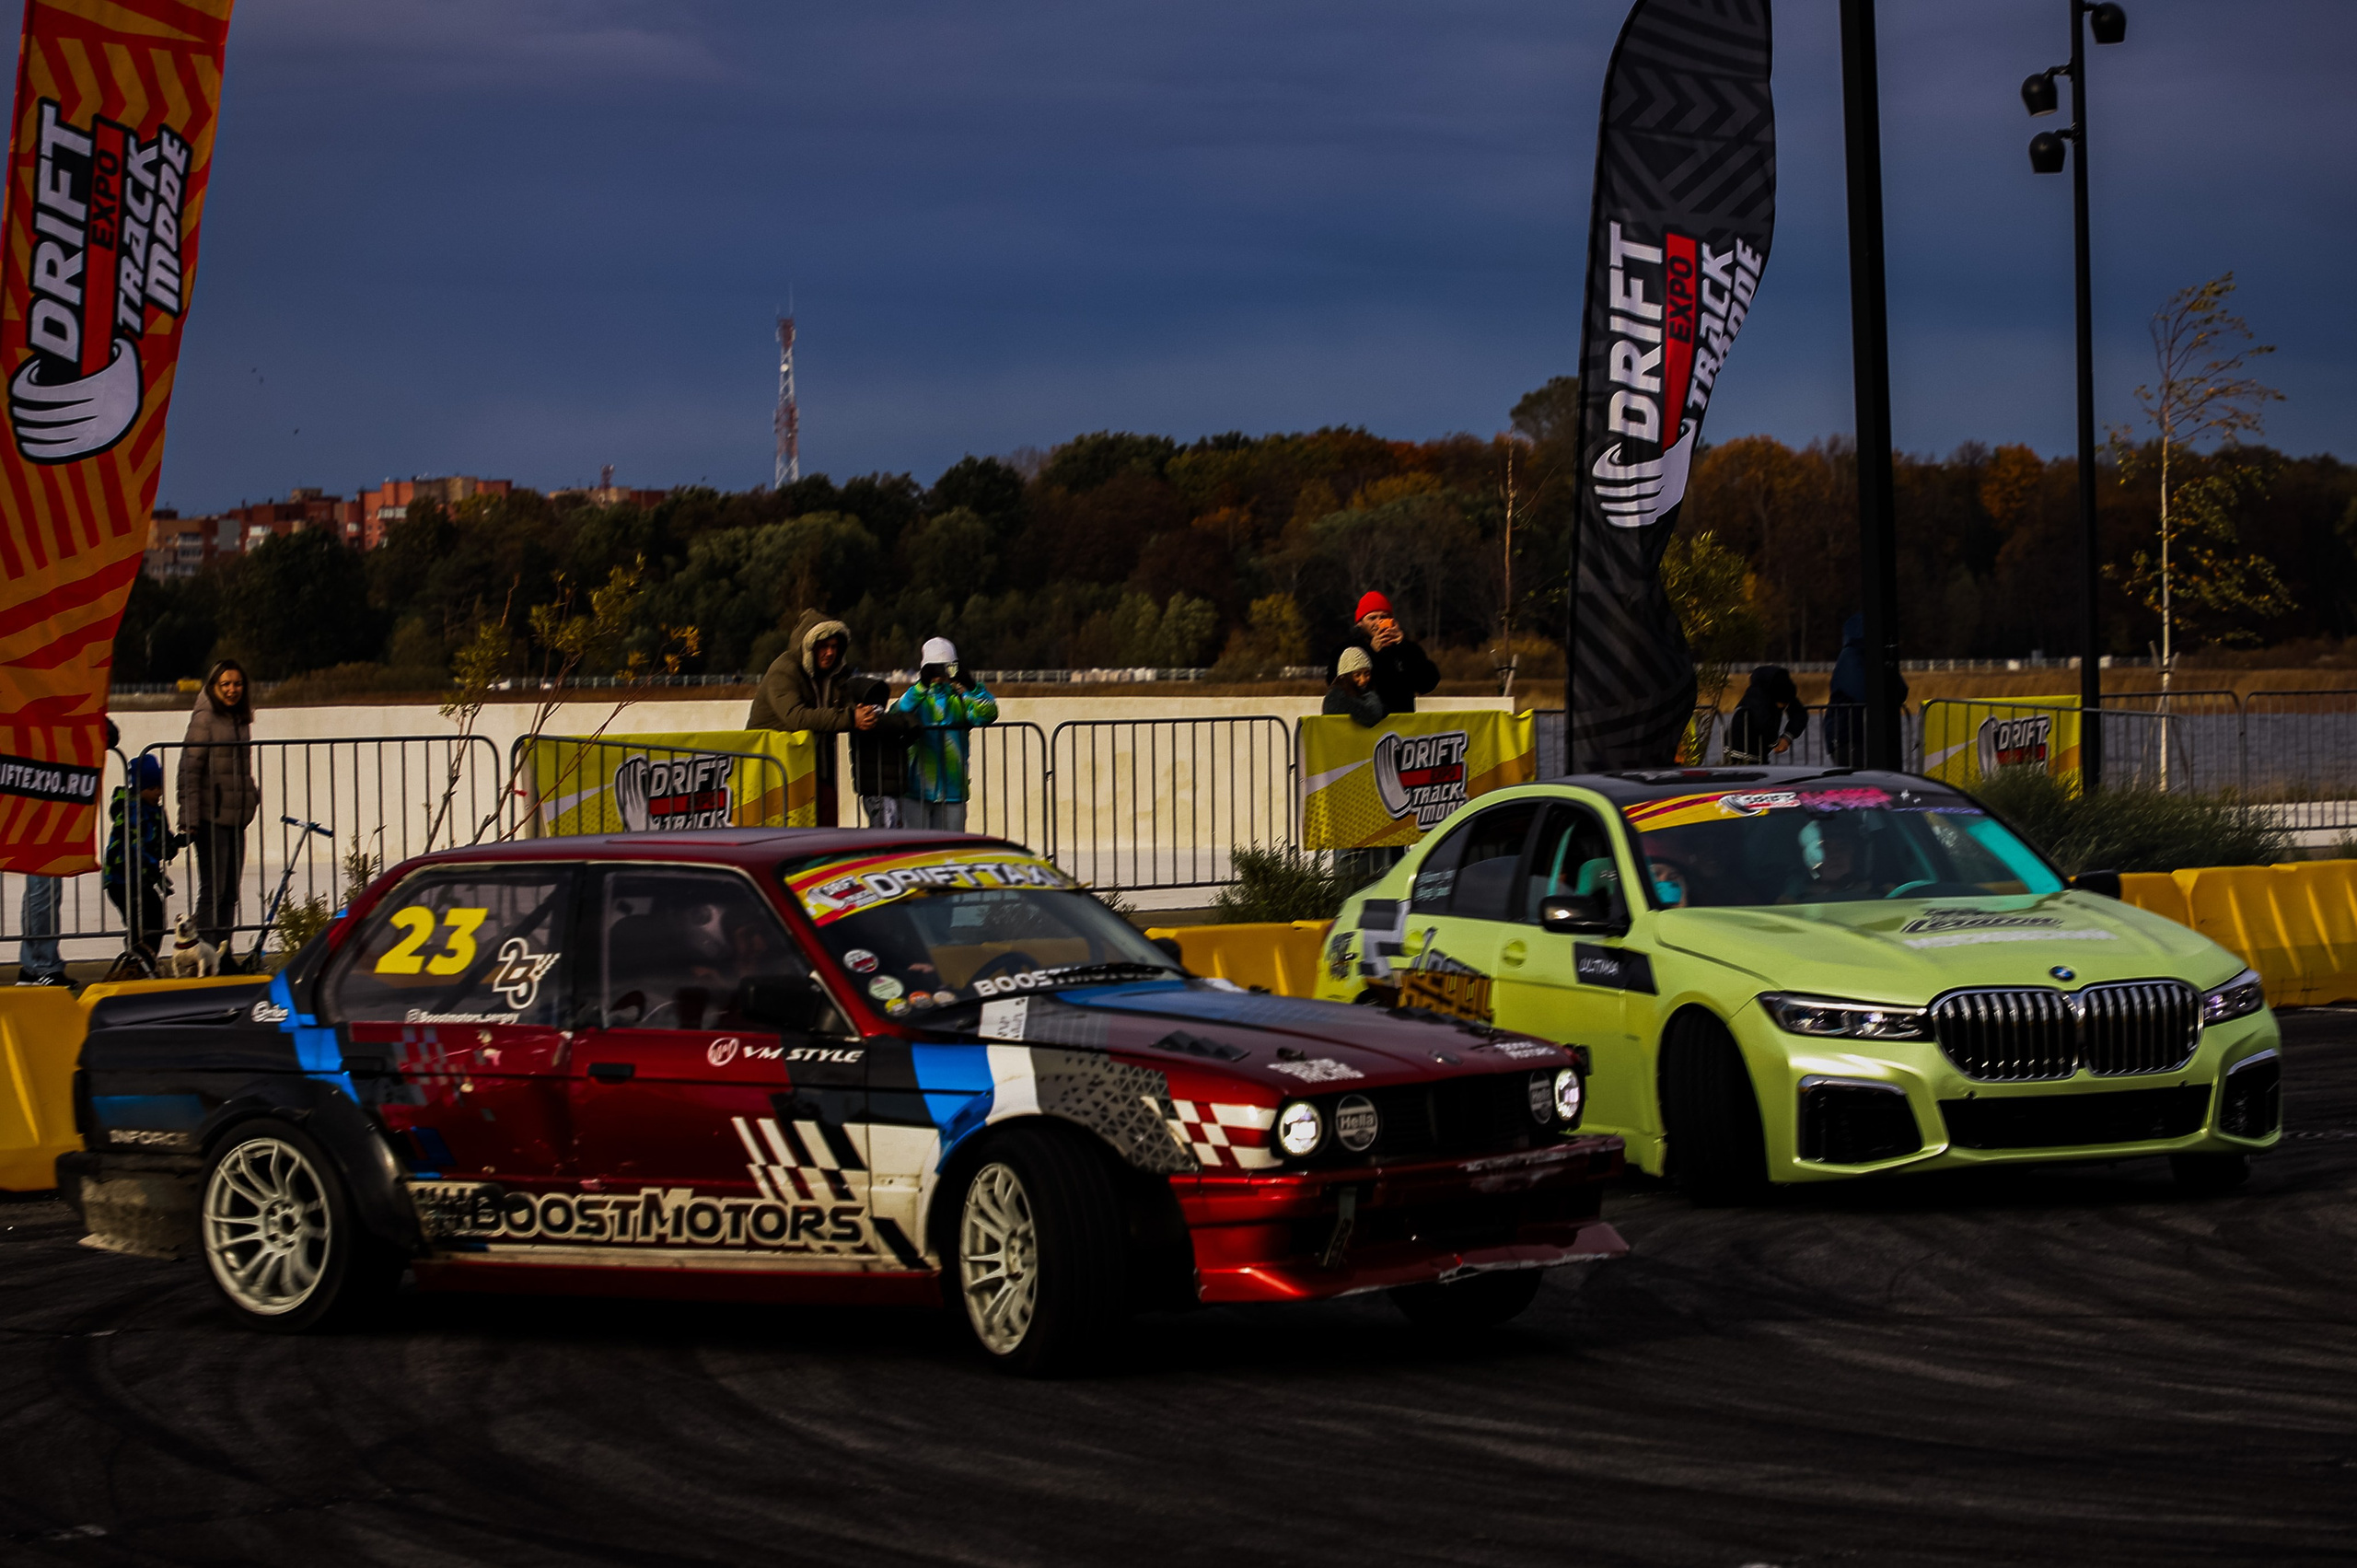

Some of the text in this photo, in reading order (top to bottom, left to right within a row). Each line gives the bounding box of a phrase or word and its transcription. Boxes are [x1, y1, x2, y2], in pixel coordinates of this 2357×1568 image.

[93, 150, 119, 250] EXPO
[29, 102, 93, 364] DRIFT
[145, 130, 189, 314] MODE
[1670, 256, 1692, 343] EXPO
[1608, 220, 1663, 443] DRIFT
[1998, 720, 2047, 750] DRIFT
[1399, 737, 1463, 772] DRIFT
[648, 760, 727, 798] DRIFT
[1412, 783, 1462, 805] TRACK
[863, 865, 977, 900] DRIFT
[374, 905, 489, 975] 23
[743, 1045, 865, 1063] VM STYLE
[1338, 1112, 1376, 1131] Hella
